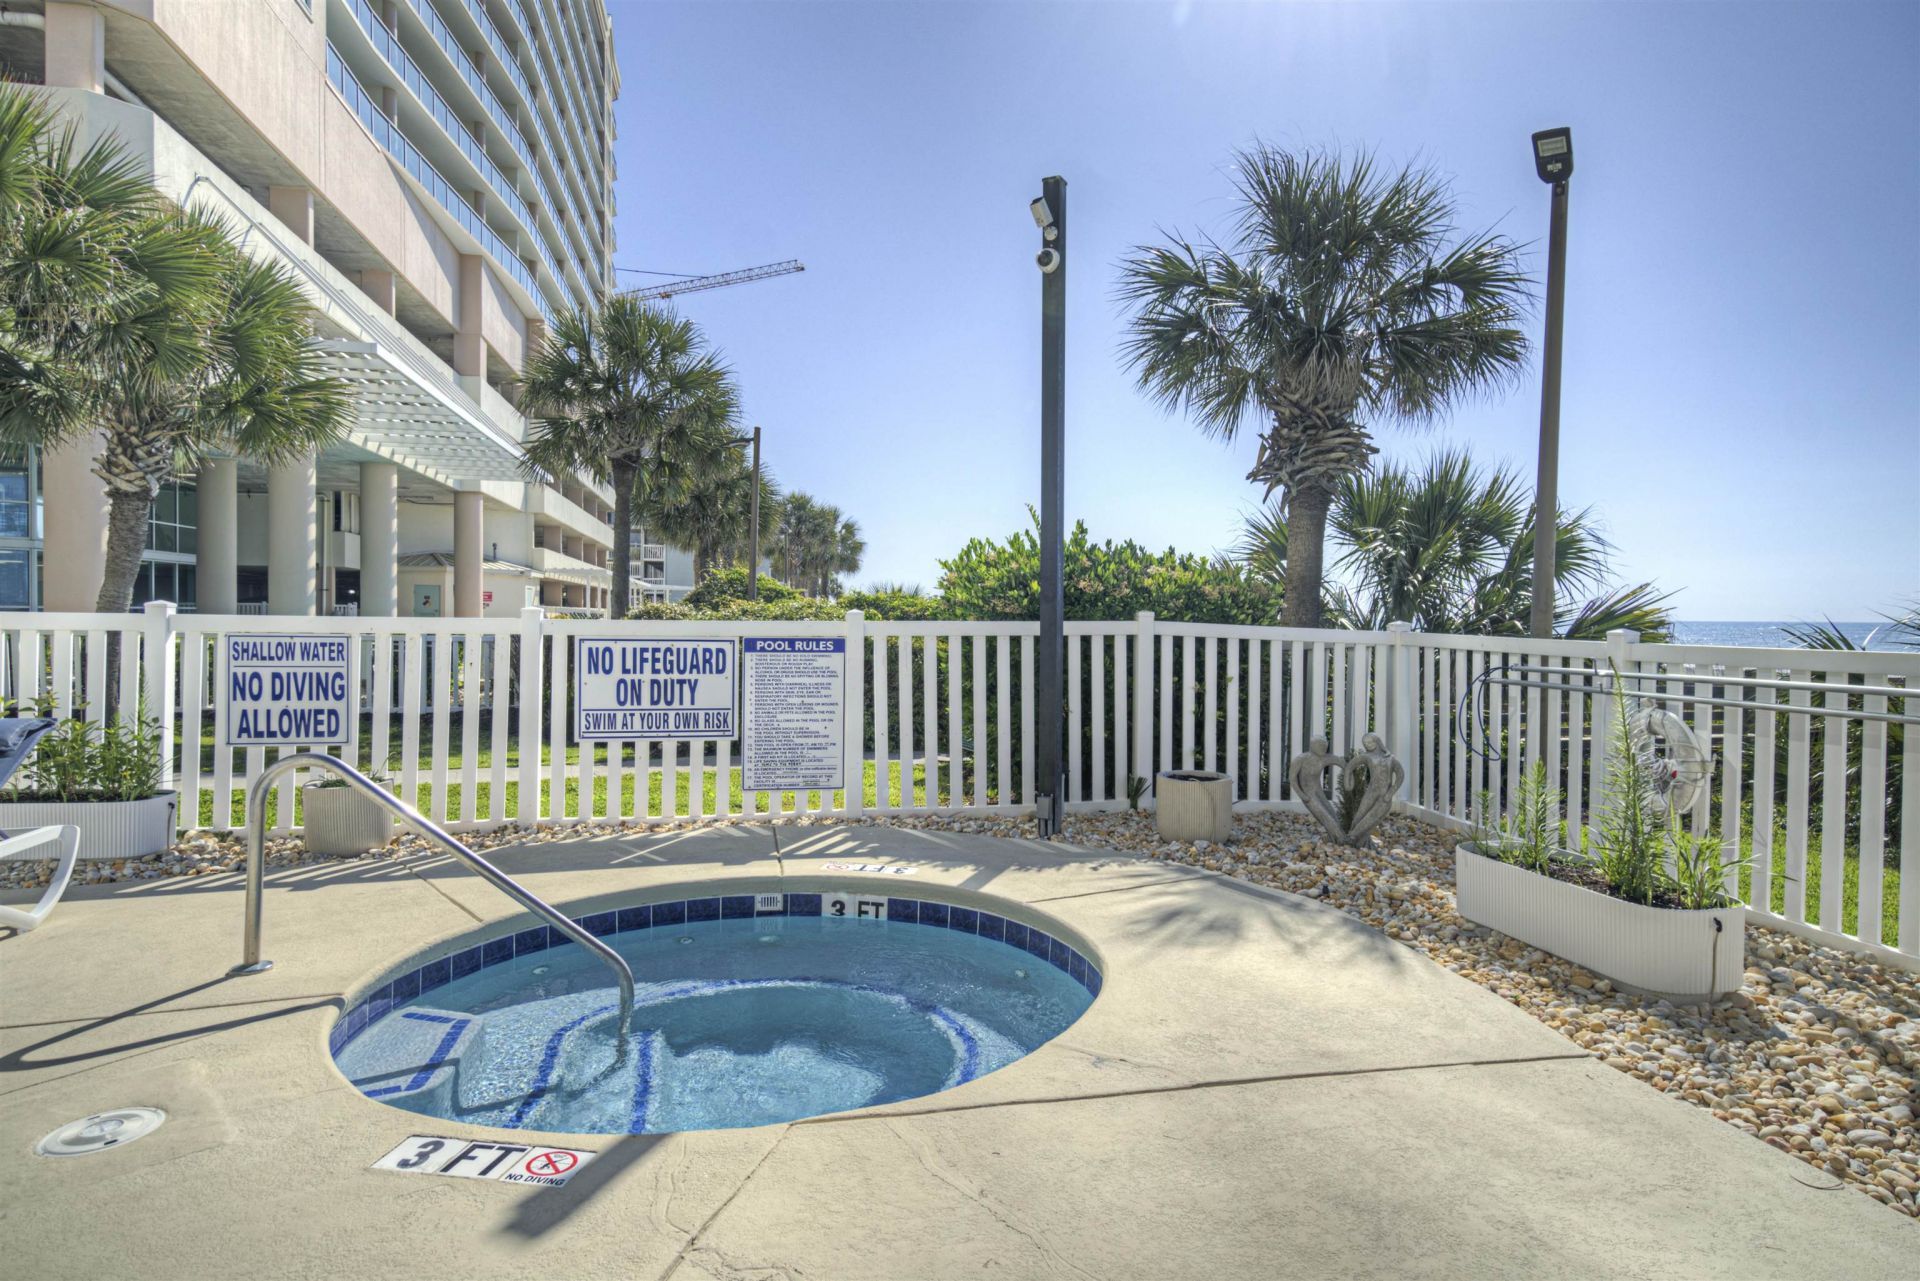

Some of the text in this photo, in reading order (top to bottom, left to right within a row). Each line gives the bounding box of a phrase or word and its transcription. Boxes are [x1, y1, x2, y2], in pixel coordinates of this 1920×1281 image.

[232, 641, 345, 662] SHALLOW WATER
[756, 640, 834, 650] POOL RULES
[588, 646, 726, 674] NO LIFEGUARD
[232, 672, 345, 702] NO DIVING
[616, 678, 698, 706] ON DUTY
[237, 708, 340, 738] ALLOWED
[584, 712, 729, 730] SWIM AT YOUR OWN RISK
[831, 900, 884, 918] 3 FT
[396, 1140, 526, 1176] 3 FT
[505, 1174, 566, 1186] NO DIVING
